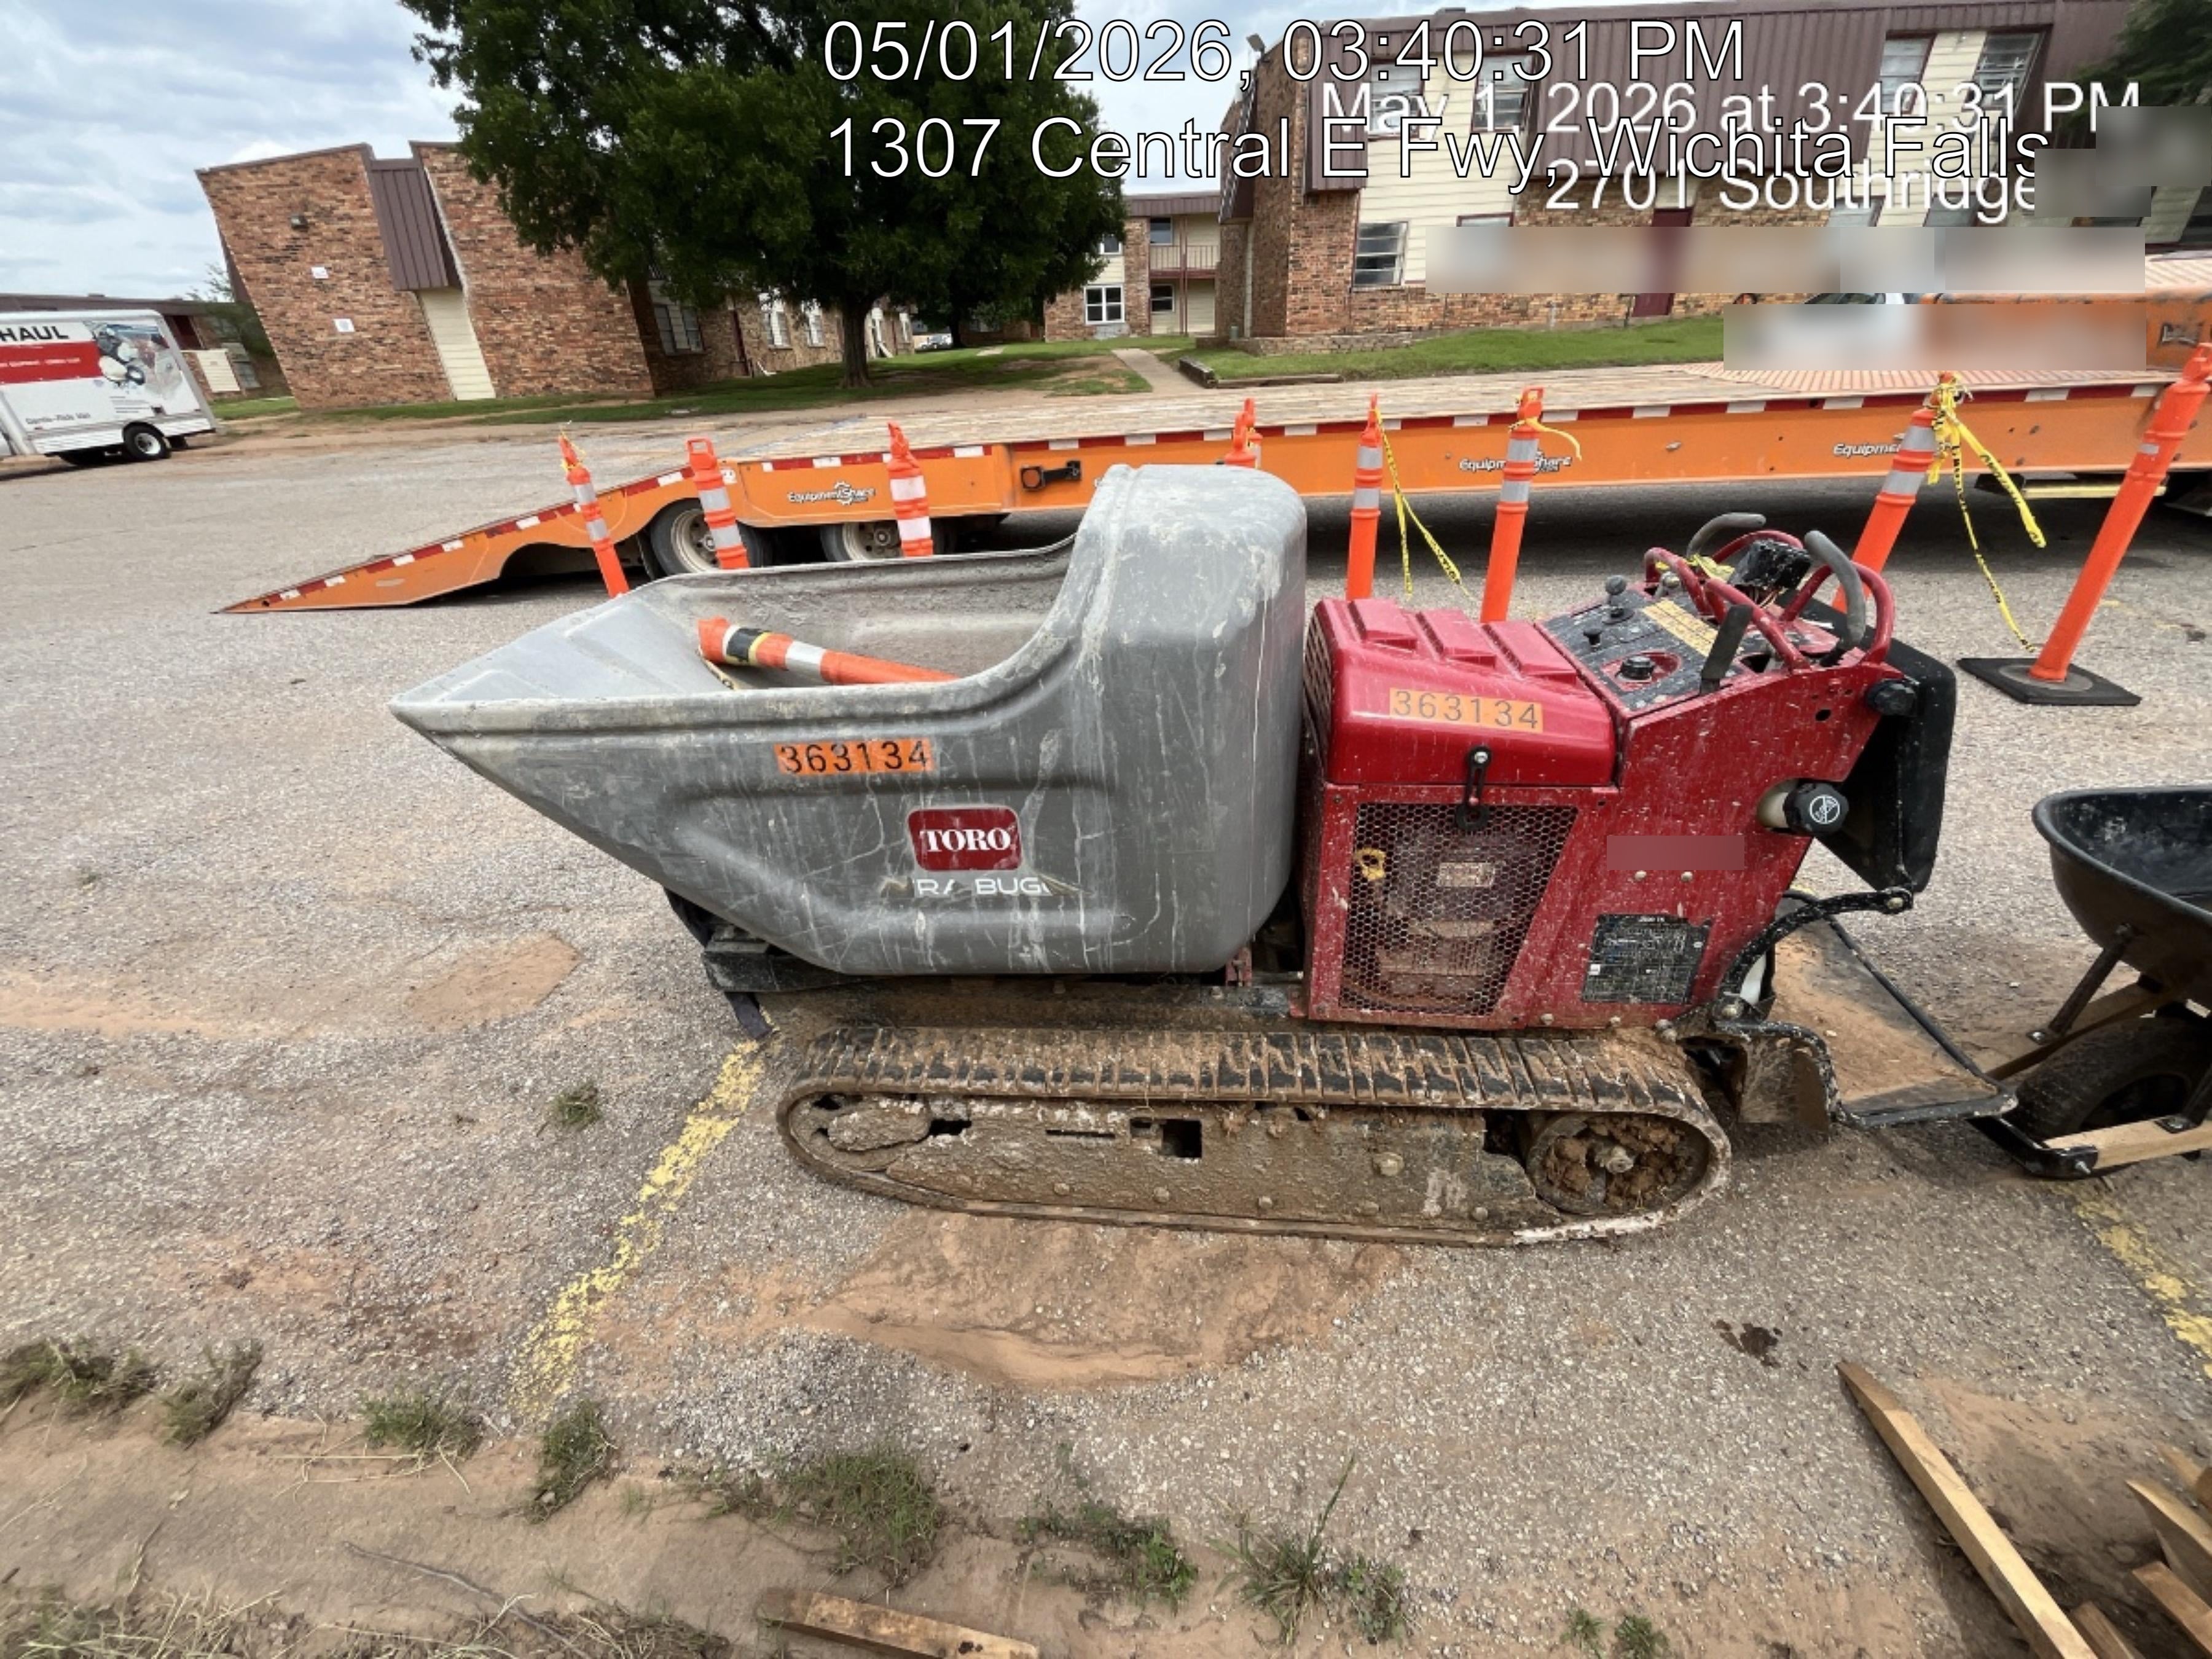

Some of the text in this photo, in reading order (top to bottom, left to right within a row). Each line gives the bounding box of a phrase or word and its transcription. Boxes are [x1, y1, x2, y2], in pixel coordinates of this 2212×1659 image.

[1394, 690, 1538, 729] 363134
[780, 740, 928, 774] 363134
[924, 828, 1011, 853] TORO
